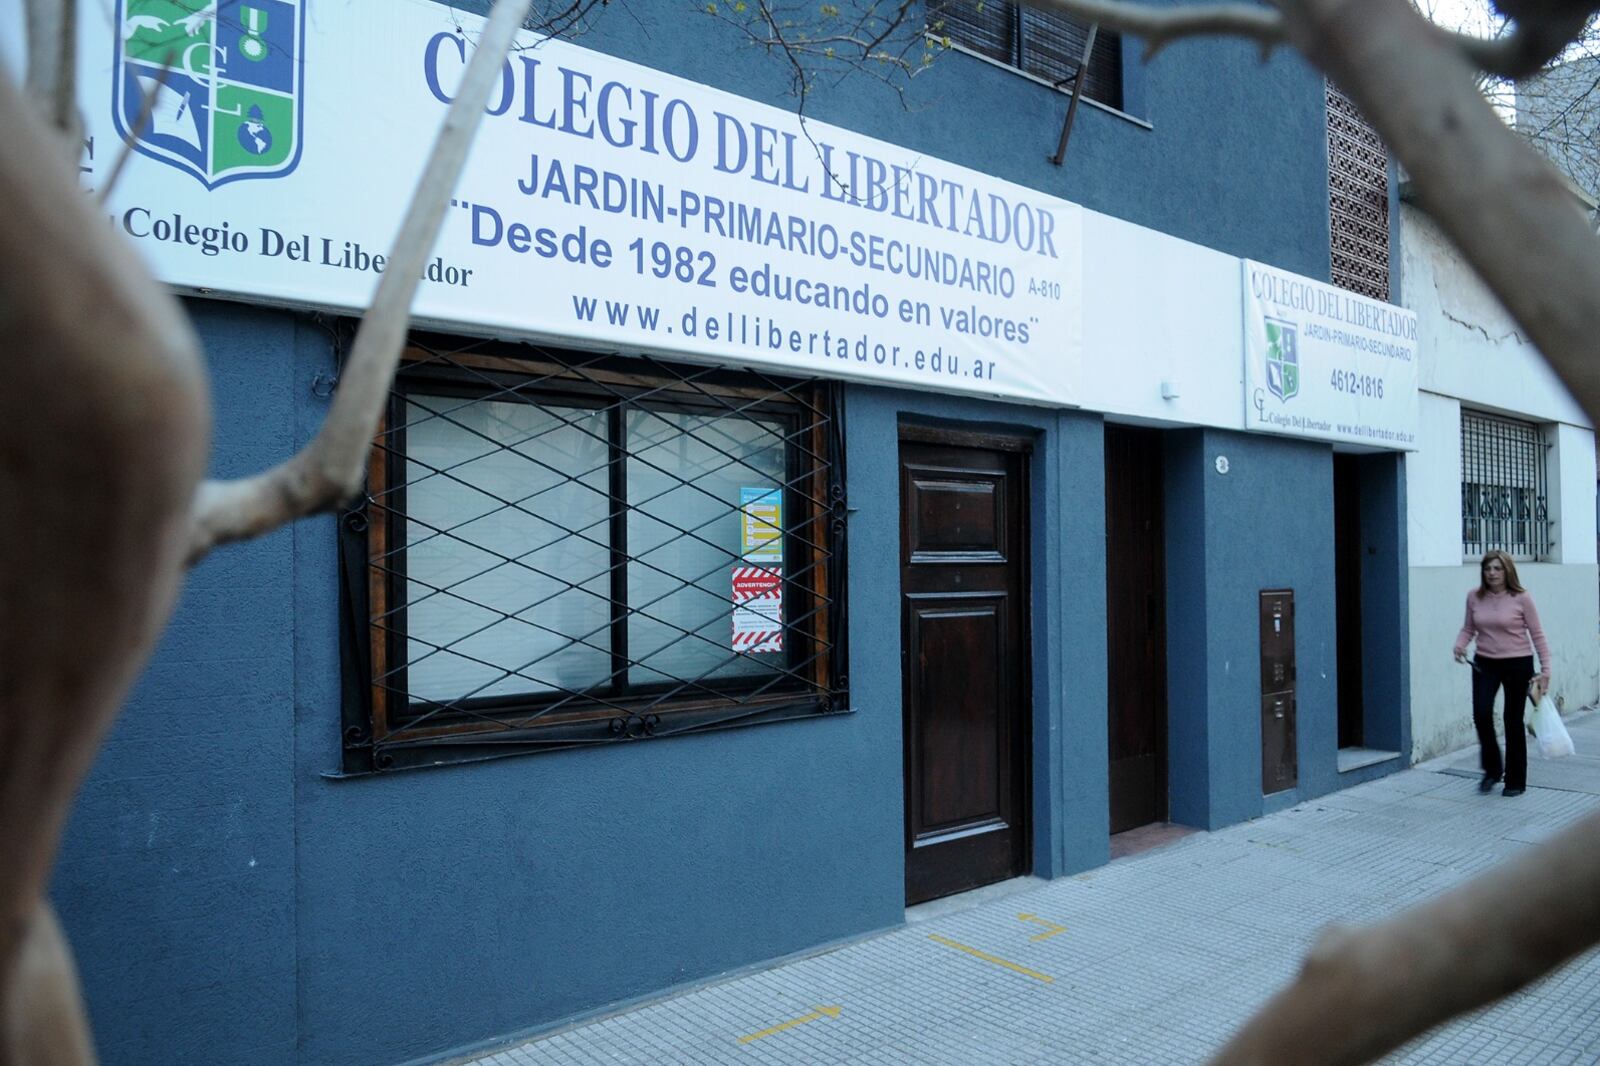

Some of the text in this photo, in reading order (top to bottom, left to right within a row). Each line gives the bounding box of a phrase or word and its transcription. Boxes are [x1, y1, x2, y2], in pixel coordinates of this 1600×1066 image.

[517, 154, 1015, 299] JARDIN-PRIMARIO-SECUNDARIO
[713, 111, 809, 194] DEL
[819, 142, 1059, 259] LIBERTADOR
[122, 207, 473, 287] Colegio Del Libedor
[629, 237, 717, 287] 1982
[729, 263, 889, 318] educando
[898, 299, 931, 326] en
[1027, 277, 1061, 300] A-810
[571, 294, 995, 380] www.dellibertador.edu.ar
[1252, 271, 1418, 341] COLEGIO DEL LIBERTADOR
[1304, 322, 1412, 361] JARDIN-PRIMARIO-SECUNDARIO
